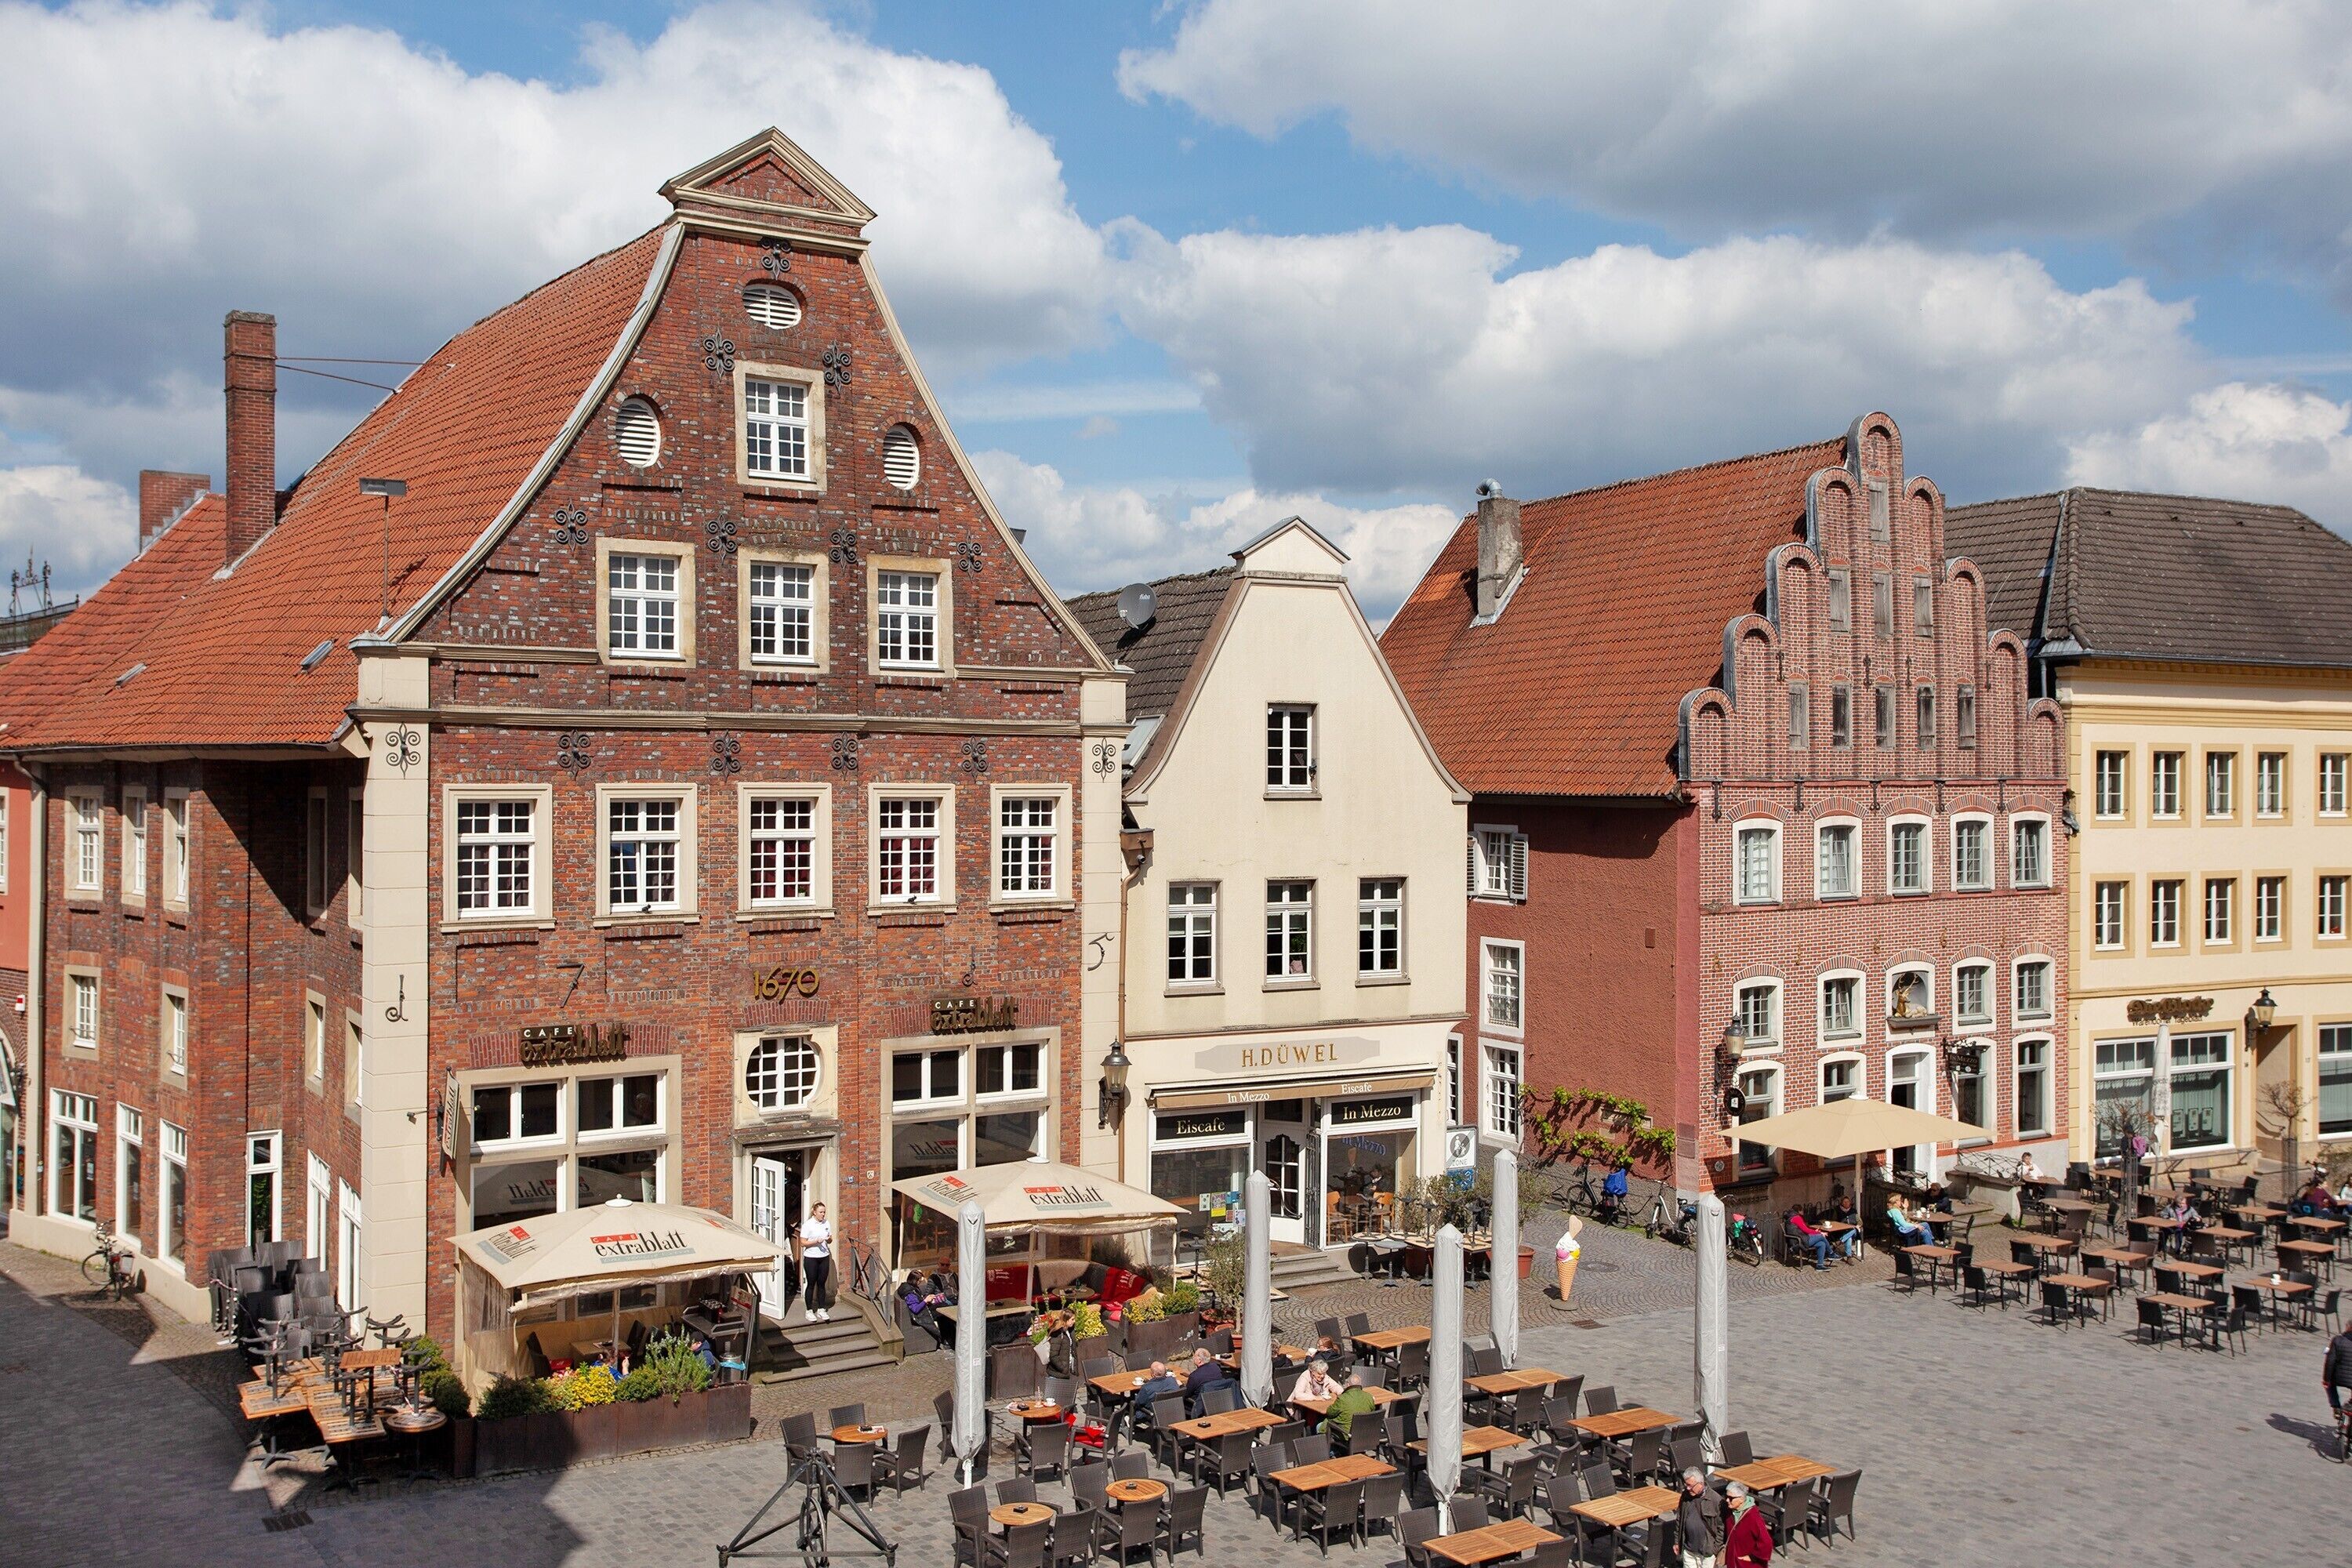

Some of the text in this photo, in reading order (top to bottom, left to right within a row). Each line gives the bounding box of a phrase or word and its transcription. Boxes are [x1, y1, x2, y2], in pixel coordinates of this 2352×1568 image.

[753, 963, 819, 1003] 1670
[935, 1000, 974, 1009] CAFE
[931, 996, 1016, 1030] extrablatt
[524, 1027, 573, 1037] CAFE
[520, 1022, 626, 1062] extrablatt
[1341, 1082, 1372, 1094] Eiscafe
[1227, 1092, 1270, 1103] In Mezzo
[1343, 1105, 1401, 1120] In Mezzo
[1176, 1117, 1225, 1134] Eiscafe
[1029, 1185, 1105, 1205] extrablatt
[592, 1234, 637, 1243] CAFE
[595, 1229, 687, 1257] extrablatt
